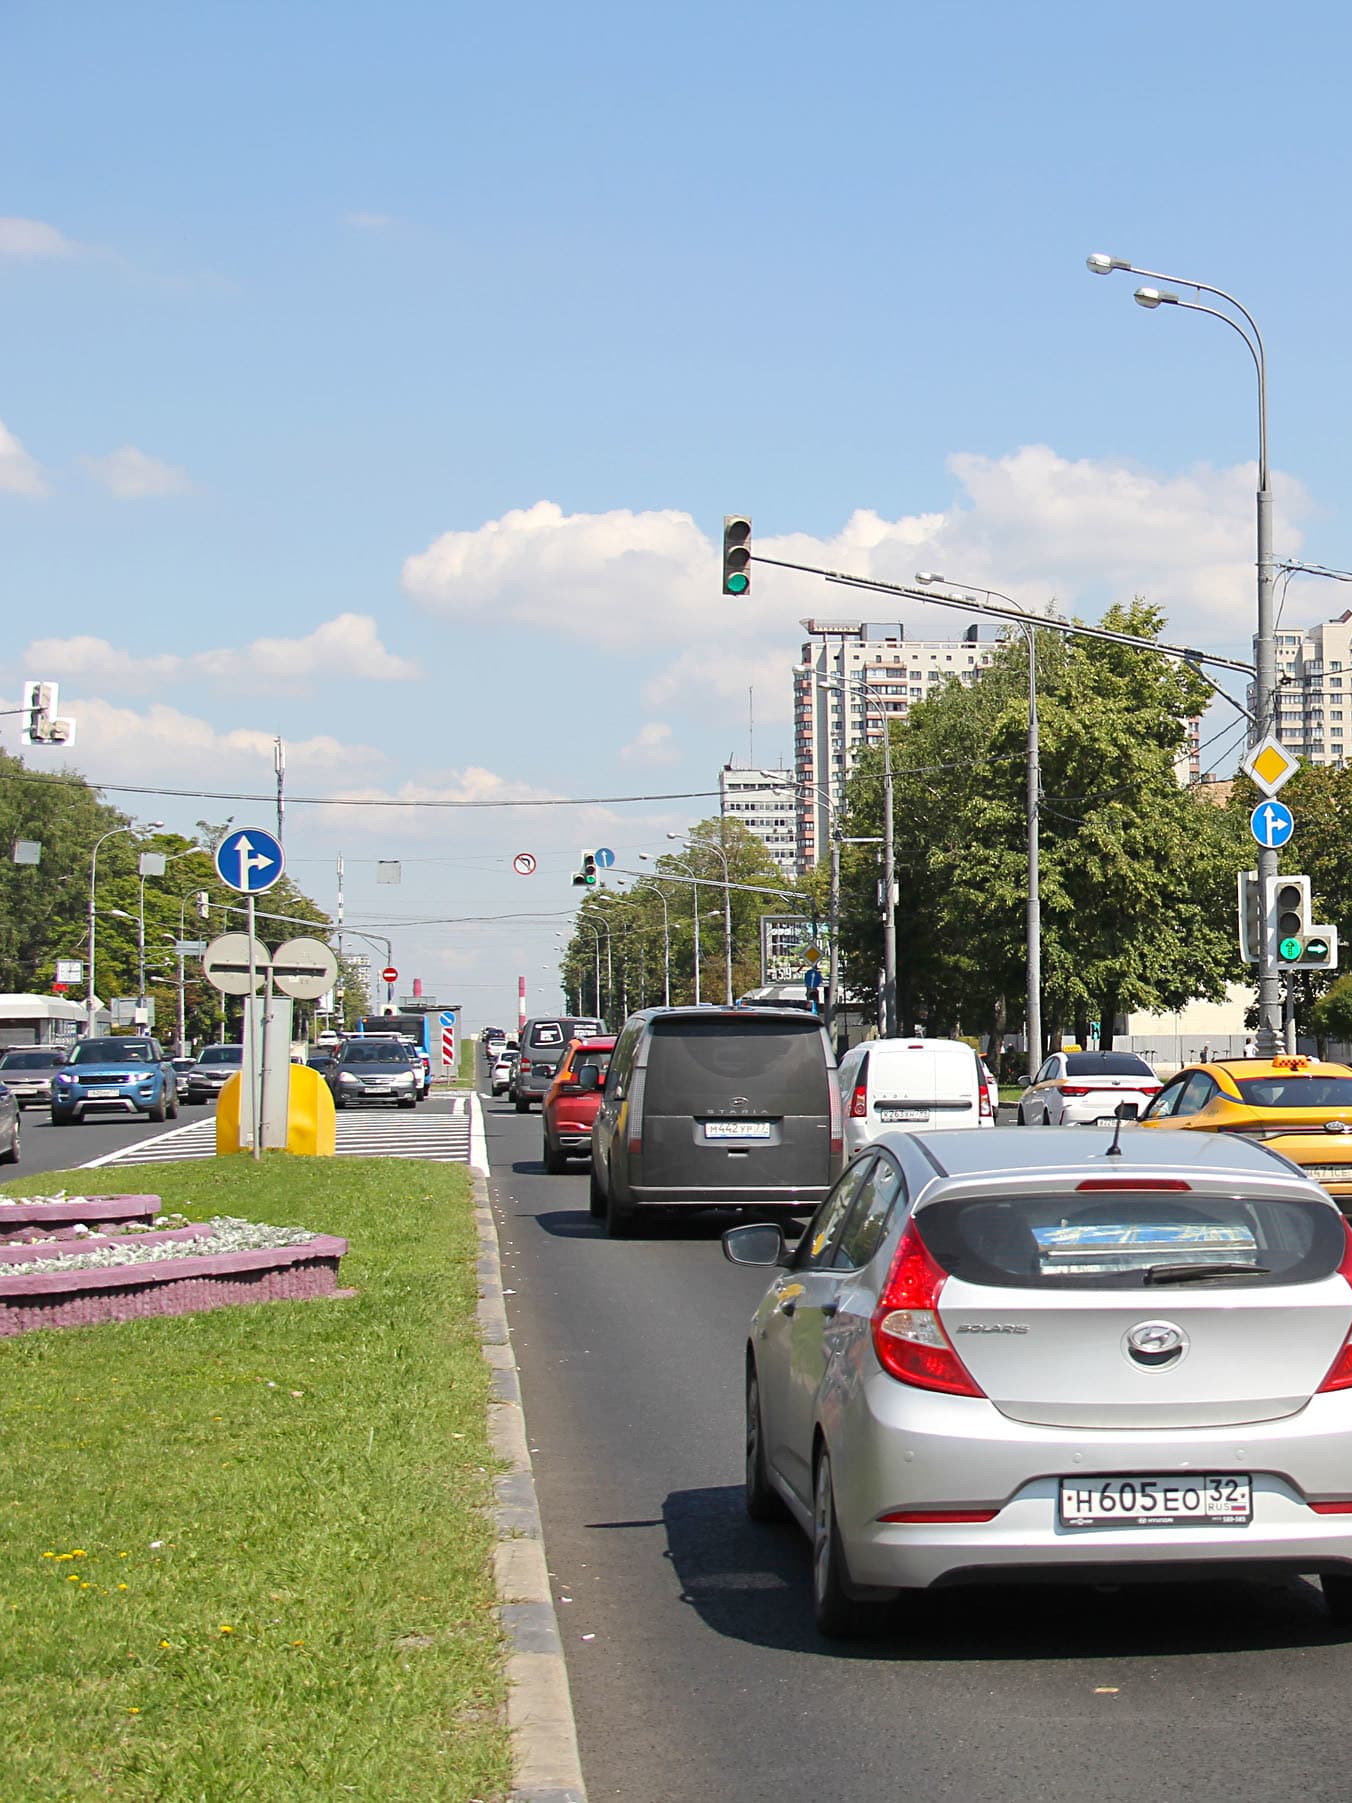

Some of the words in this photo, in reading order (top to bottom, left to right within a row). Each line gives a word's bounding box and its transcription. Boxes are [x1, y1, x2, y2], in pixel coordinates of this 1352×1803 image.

[956, 1324, 1030, 1335] SOLARIS
[1077, 1481, 1201, 1513] Н605ЕО
[1209, 1479, 1239, 1502] 32
[1208, 1502, 1230, 1511] RUS
